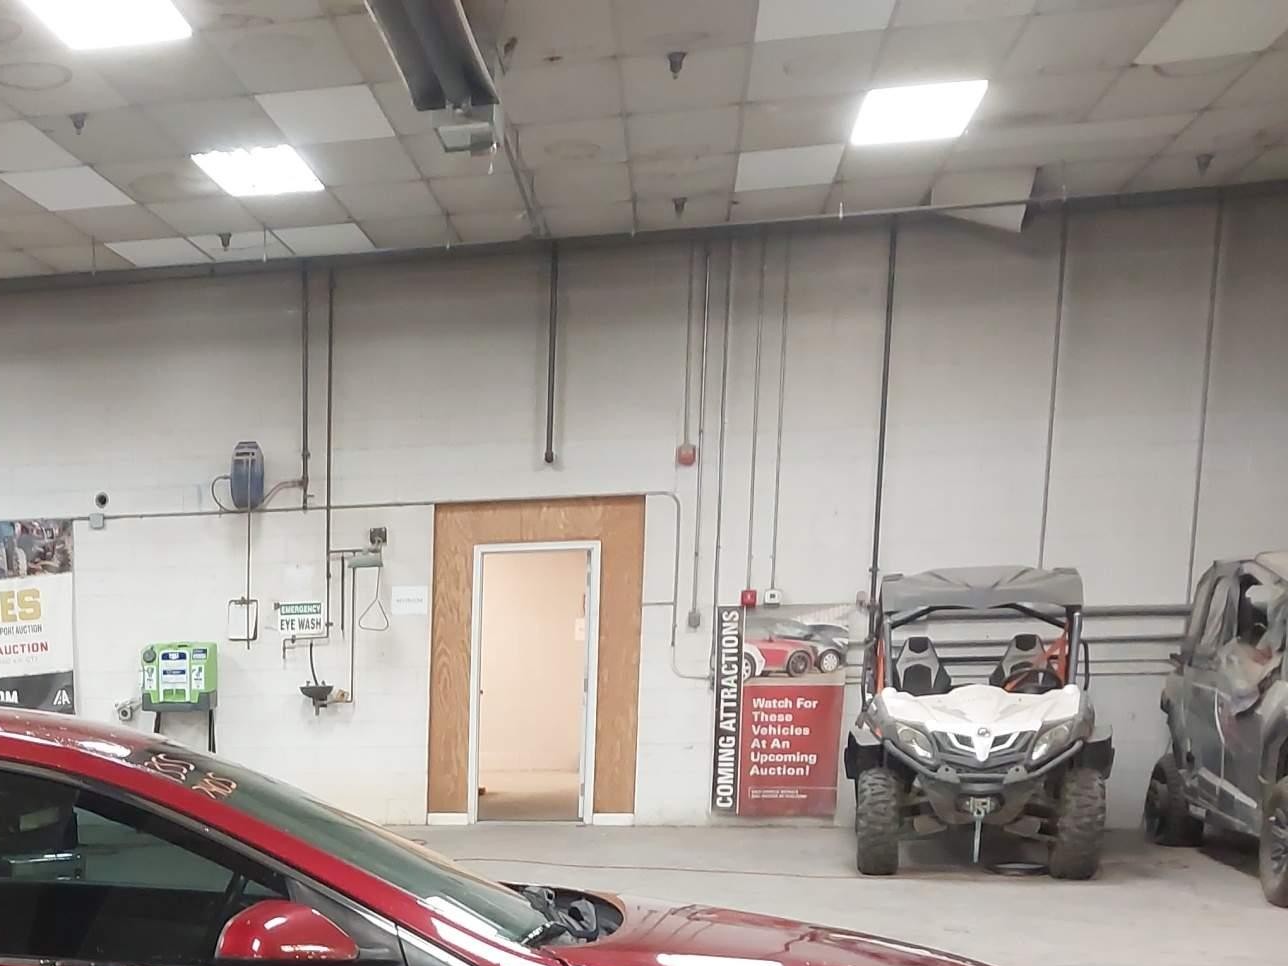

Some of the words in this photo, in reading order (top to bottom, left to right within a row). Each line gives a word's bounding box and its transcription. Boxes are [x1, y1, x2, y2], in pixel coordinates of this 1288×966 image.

[281, 604, 321, 614] EMERGENCY
[15, 624, 43, 635] AUCTION
[280, 618, 296, 631] EYE
[298, 618, 321, 630] WASH
[719, 610, 740, 732] ATTRACTIONS
[752, 697, 793, 709] Watch
[796, 697, 818, 709] For
[752, 711, 793, 722] These
[751, 724, 810, 736] Vehicles
[751, 738, 767, 749] At
[771, 738, 790, 749] An
[750, 752, 817, 765] Upcoming
[716, 736, 736, 808] COMING
[749, 764, 810, 776] Auction!
